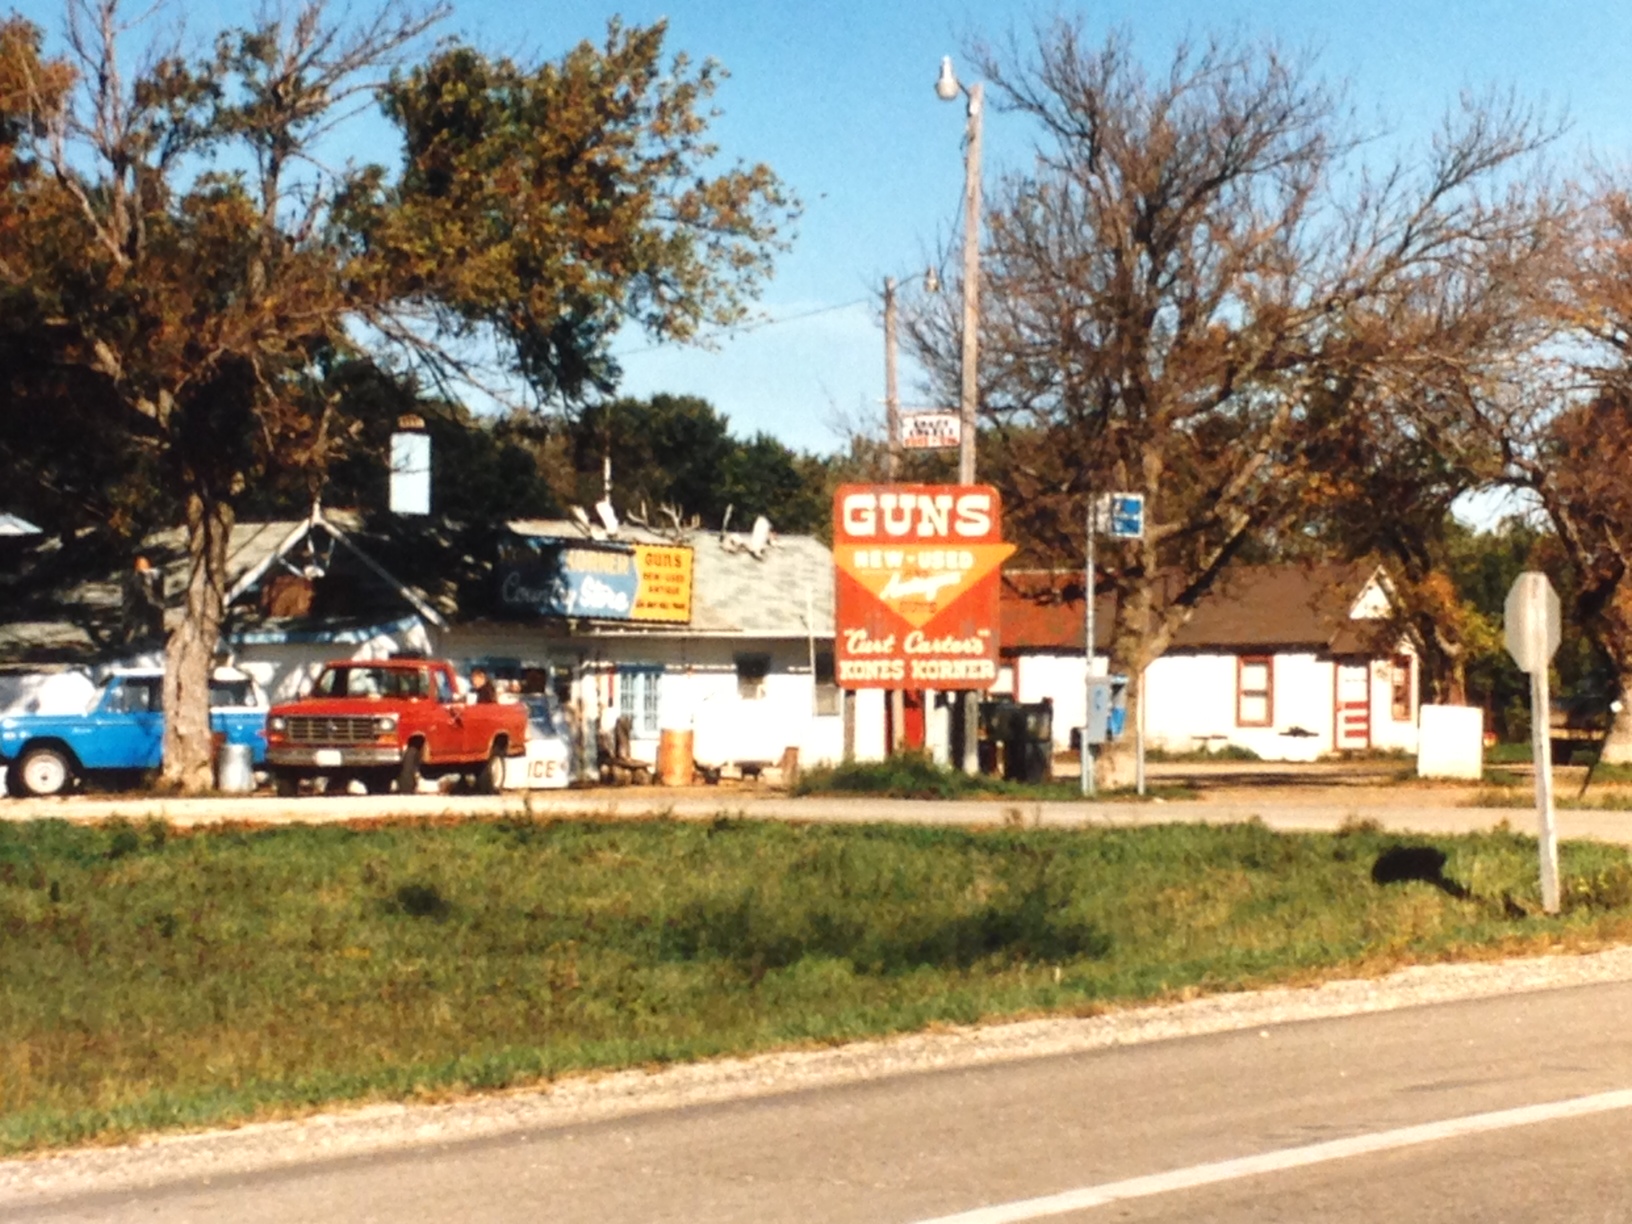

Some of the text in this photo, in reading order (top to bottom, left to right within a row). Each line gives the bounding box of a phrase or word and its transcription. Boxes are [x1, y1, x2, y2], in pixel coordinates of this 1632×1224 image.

[843, 493, 991, 537] GUNS
[645, 553, 682, 569] GUNS
[839, 659, 995, 680] KONES KORNER
[527, 760, 556, 778] ICE
